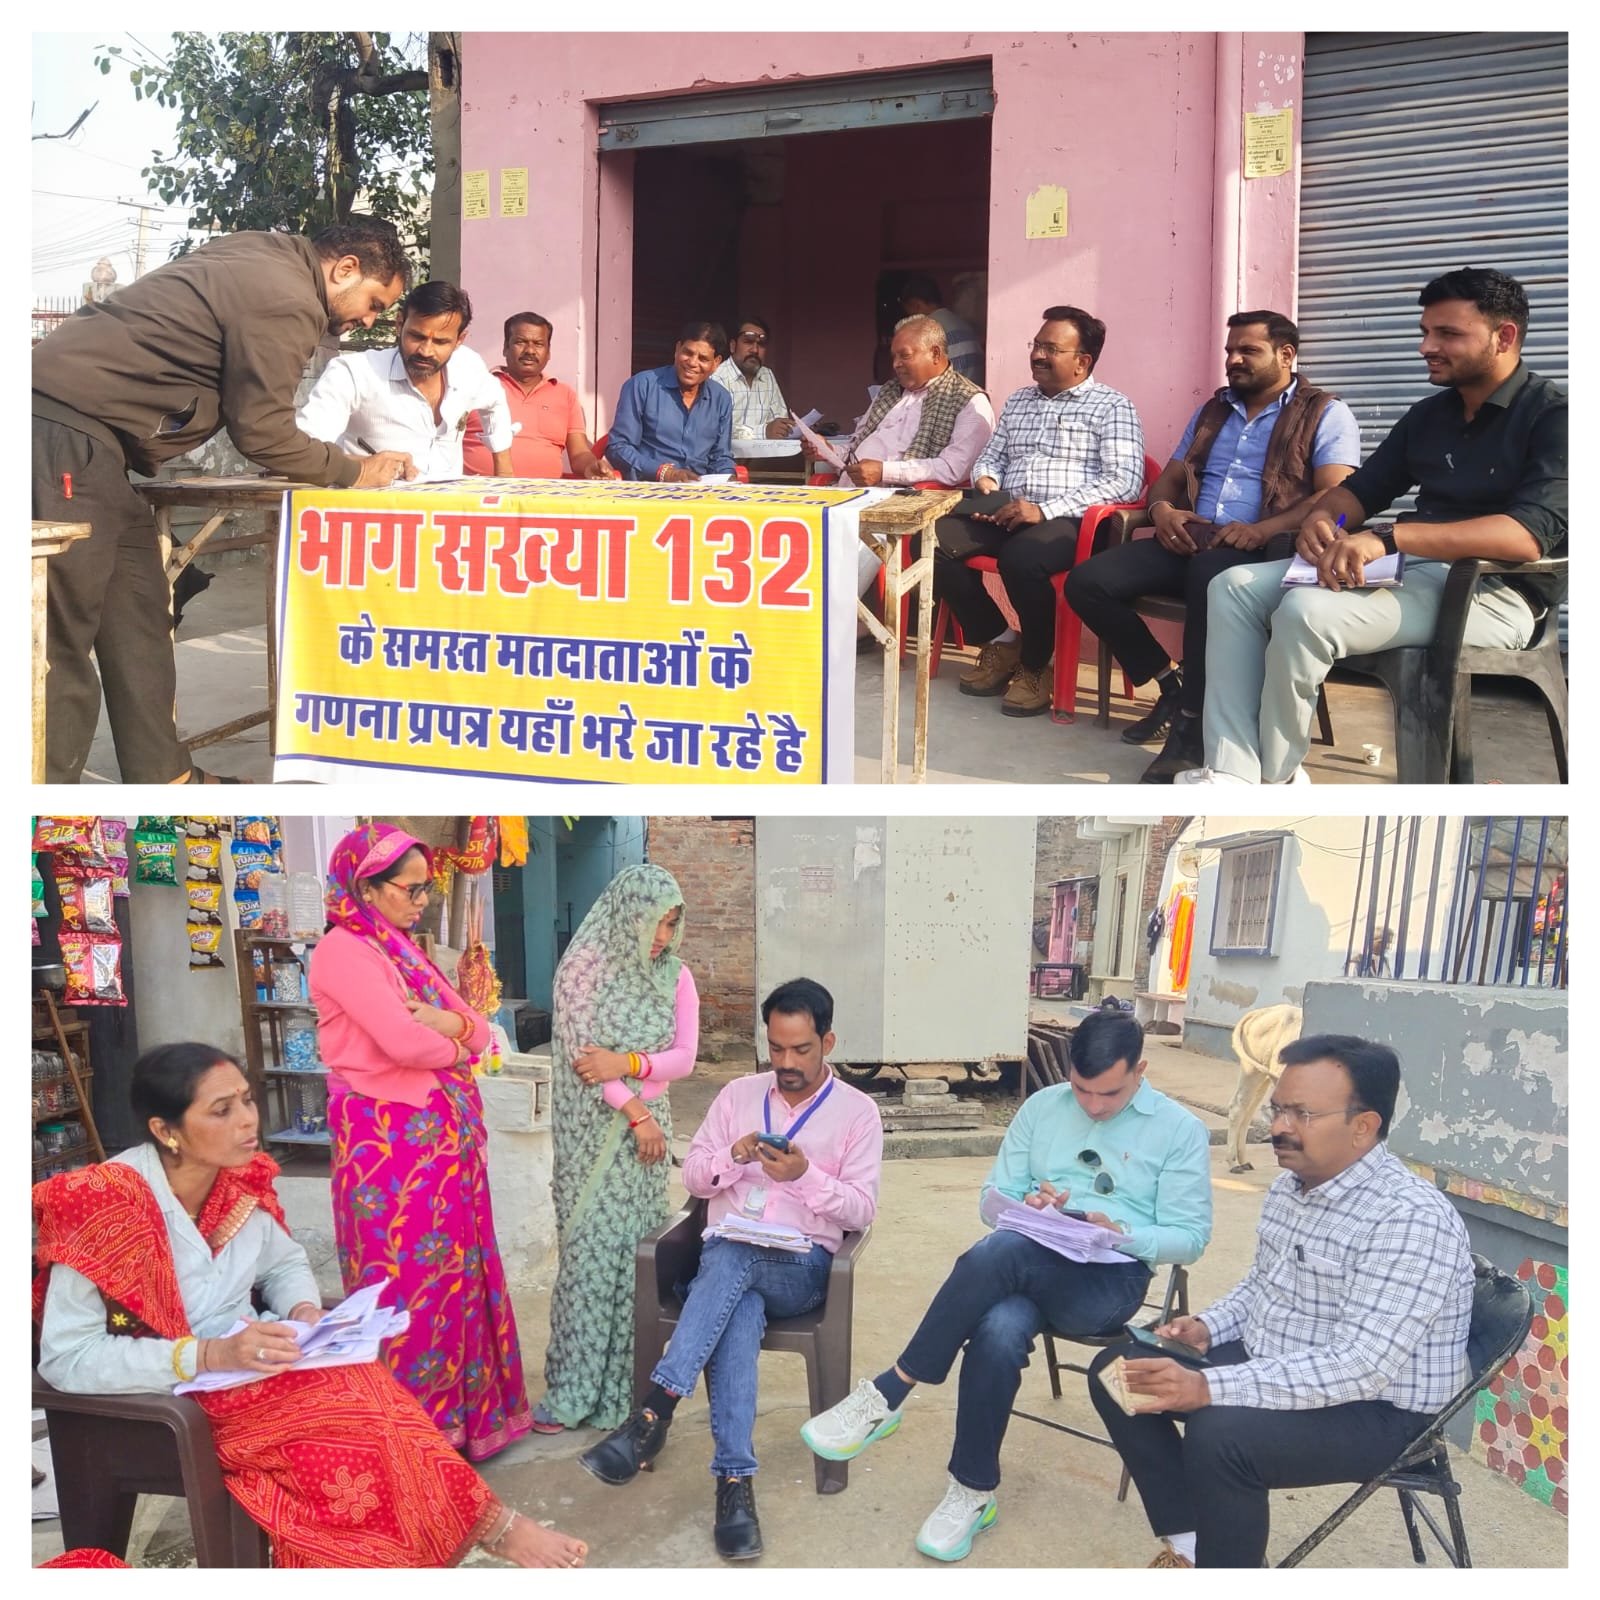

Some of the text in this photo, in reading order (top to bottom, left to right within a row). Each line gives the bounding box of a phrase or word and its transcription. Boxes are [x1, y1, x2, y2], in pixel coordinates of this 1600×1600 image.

[299, 495, 810, 607] भाग संख्या 132
[339, 613, 753, 689] के समस्त मतदाताओं के
[295, 693, 807, 773] गणना प्रपत्र यहाँ भरे जा रहे है
[138, 844, 172, 856] YUMZ!
[240, 901, 262, 913] YUM
